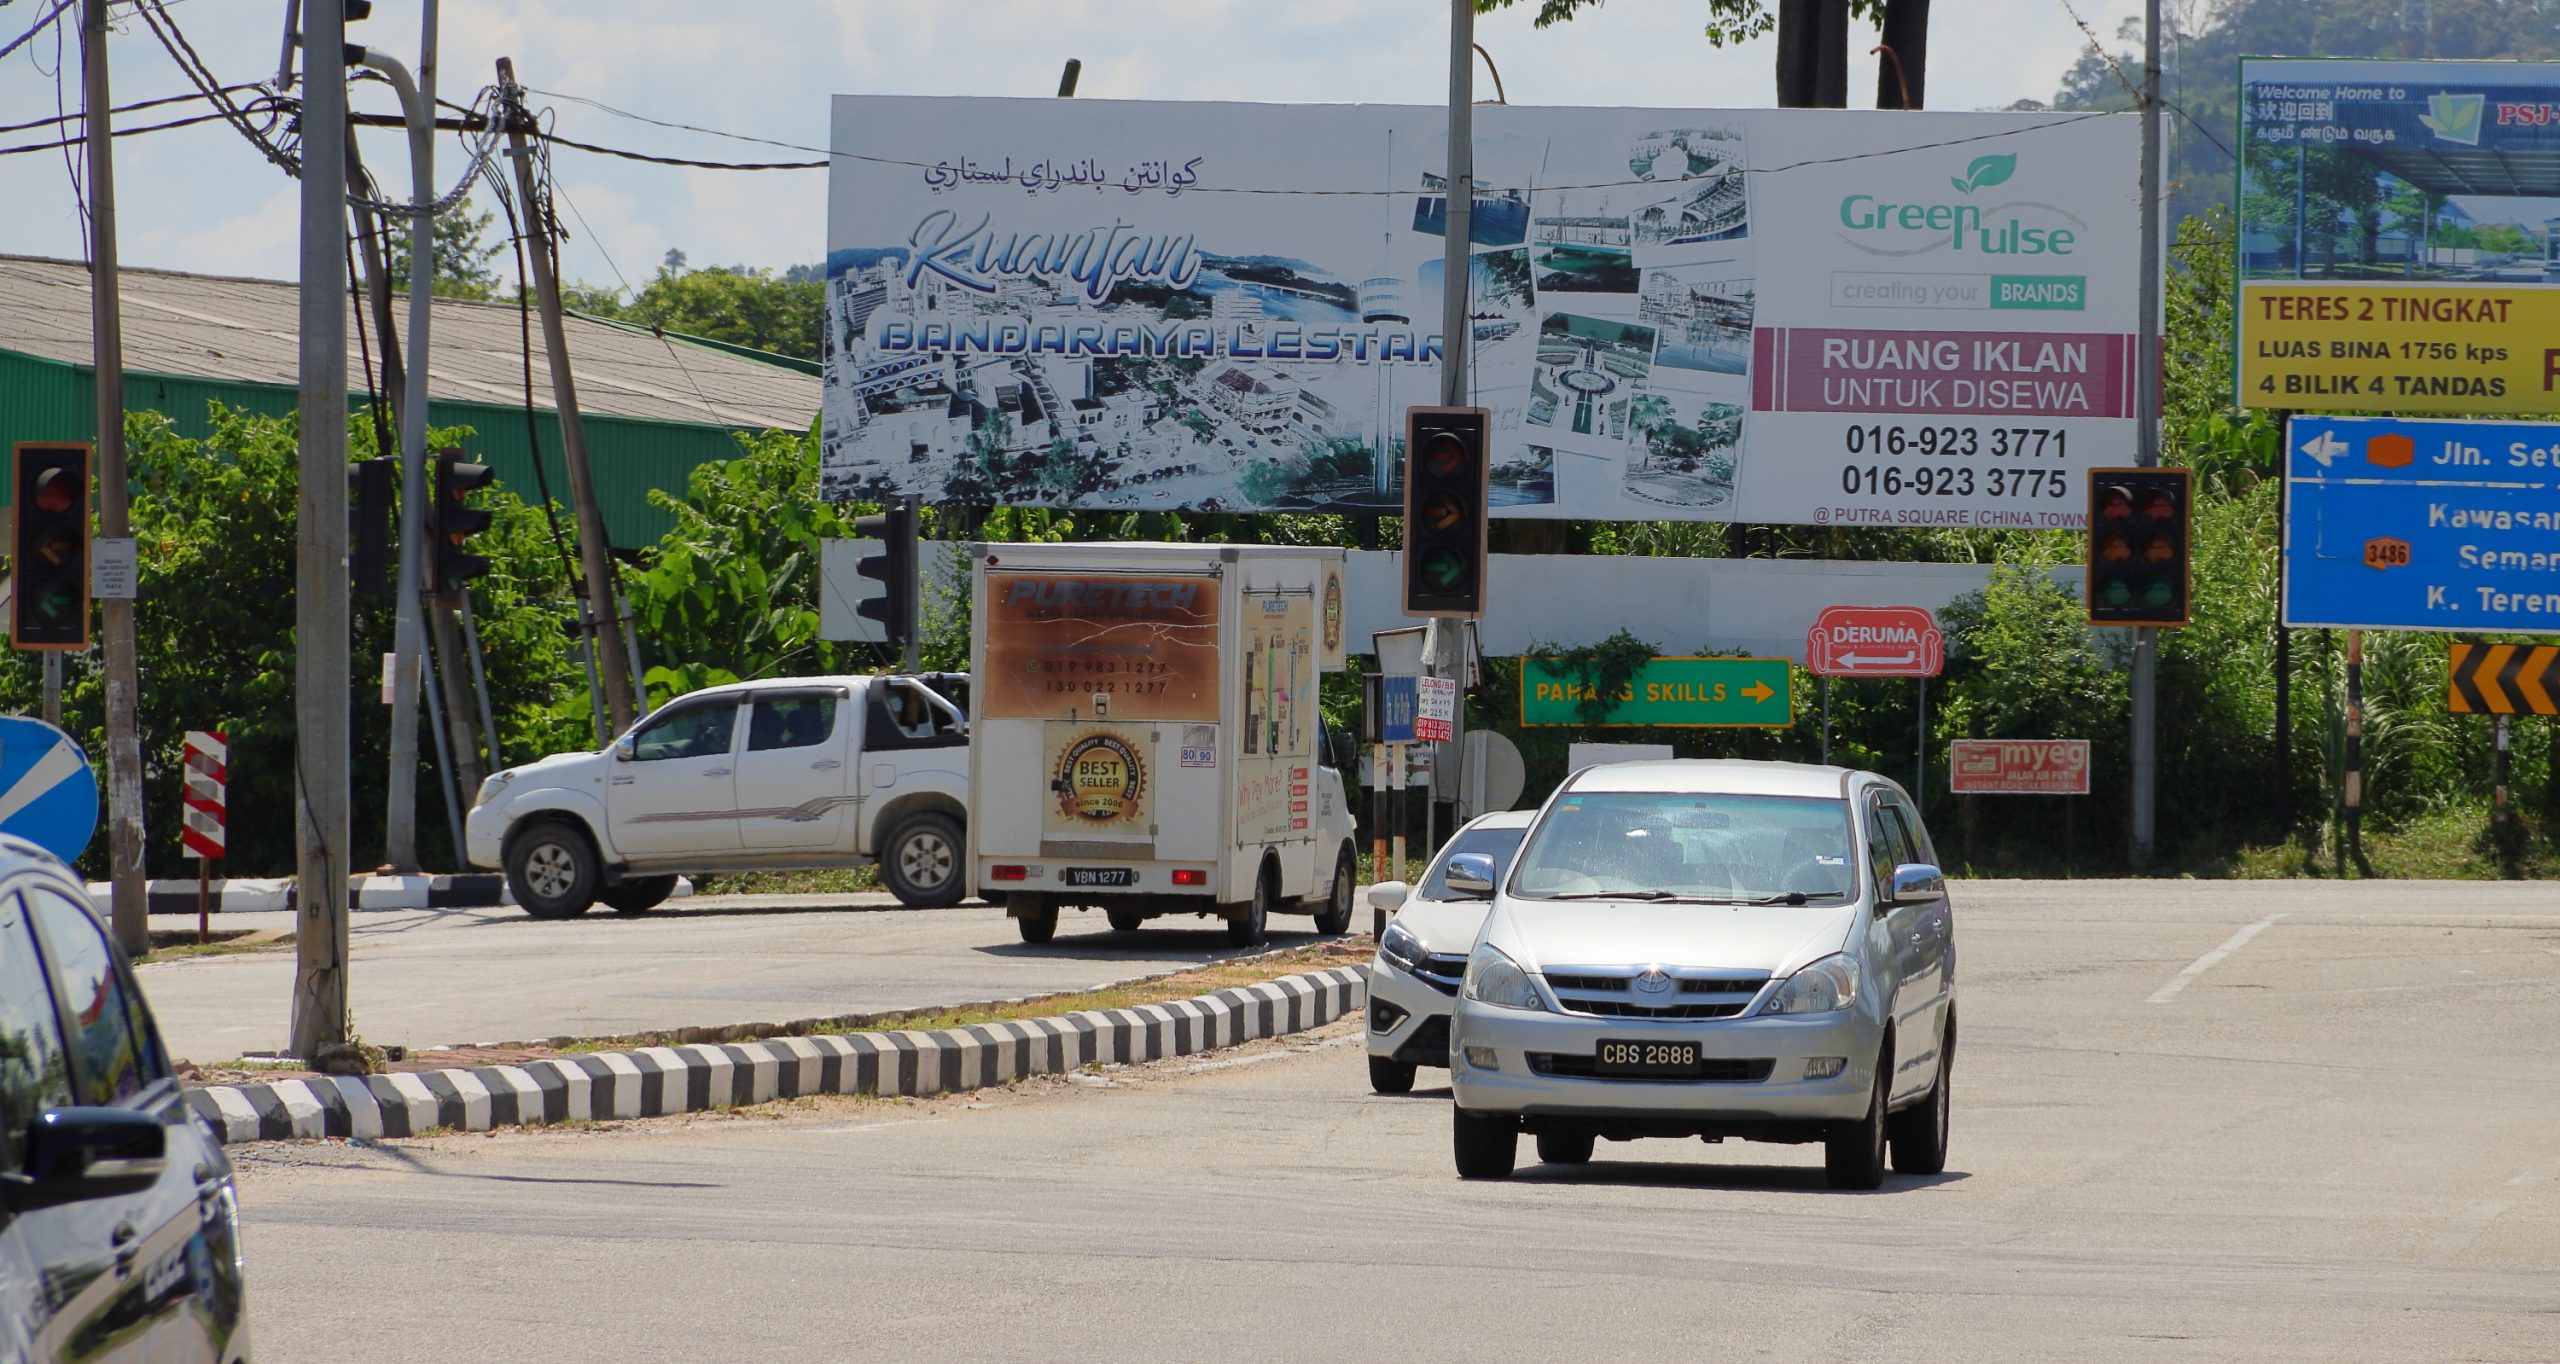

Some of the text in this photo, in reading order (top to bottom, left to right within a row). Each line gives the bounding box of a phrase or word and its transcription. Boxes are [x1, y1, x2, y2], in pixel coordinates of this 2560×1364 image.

[2257, 86, 2405, 100] Welcome Home to
[2257, 103, 2333, 122] 欢迎回到
[907, 209, 1199, 300] Kuantan
[1843, 283, 2078, 304] creating your BRANDS
[2260, 296, 2512, 323] TERES 2 TINGKAT
[879, 320, 1443, 362] BANDARAYA LESTAR
[1823, 338, 2087, 373] RUANG IKLAN
[2259, 340, 2508, 365] LUAS BINA 1756 kps
[1823, 377, 2089, 410] UNTUK DISEWA
[2259, 375, 2506, 397] 4 BILIK 4 TANDAS
[1846, 425, 2066, 458] 016-923 3771
[2432, 441, 2560, 467] Jln. Set
[1842, 465, 2067, 498] 016-923 3775
[1813, 507, 1830, 525] @
[1835, 508, 1893, 524] PUTRA
[1896, 509, 1969, 525] SQUARE
[1975, 509, 2033, 527] (CHINA
[2368, 544, 2407, 563] 3486
[1007, 581, 1199, 609] PURETECH
[2427, 585, 2459, 610] K.
[1833, 626, 1918, 643] DERUMA
[1044, 661, 1076, 673] 019
[1125, 662, 1168, 674] 1277
[1046, 680, 1167, 693] 130 022 1277
[1536, 682, 1727, 702] PAHAG SKILLS
[1182, 749, 1211, 761] 80 90
[2004, 744, 2084, 771] myeg
[1064, 738, 1137, 799] BEST QUALITY BEST QUALITY BEST
[1080, 761, 1119, 775] BEST
[1080, 777, 1120, 788] SELLER
[1075, 799, 1100, 808] since
[1074, 871, 1126, 883] VBN 1277
[1603, 1044, 1694, 1064] CBS 2688
